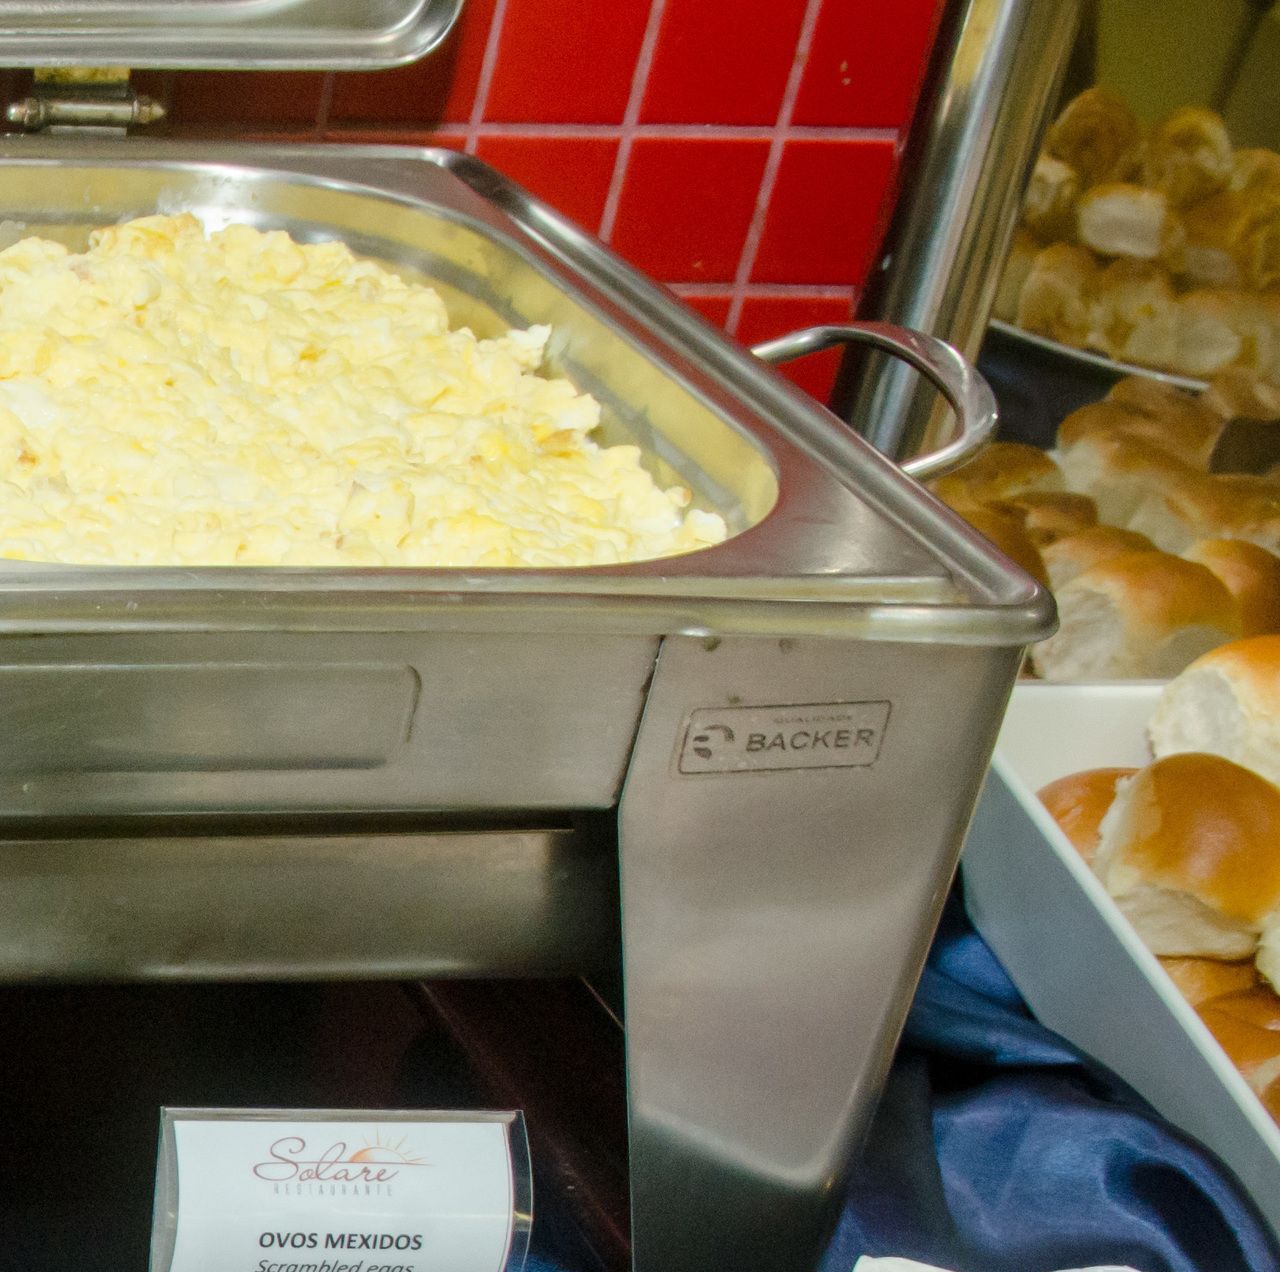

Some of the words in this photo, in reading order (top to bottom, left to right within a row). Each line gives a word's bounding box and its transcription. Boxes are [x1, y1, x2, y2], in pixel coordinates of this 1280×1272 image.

[746, 729, 874, 752] BACKER
[253, 1136, 400, 1182] Solare
[273, 1183, 393, 1196] RESTAURANTE
[259, 1232, 318, 1249] OVOS
[324, 1233, 423, 1251] MEXIDOS
